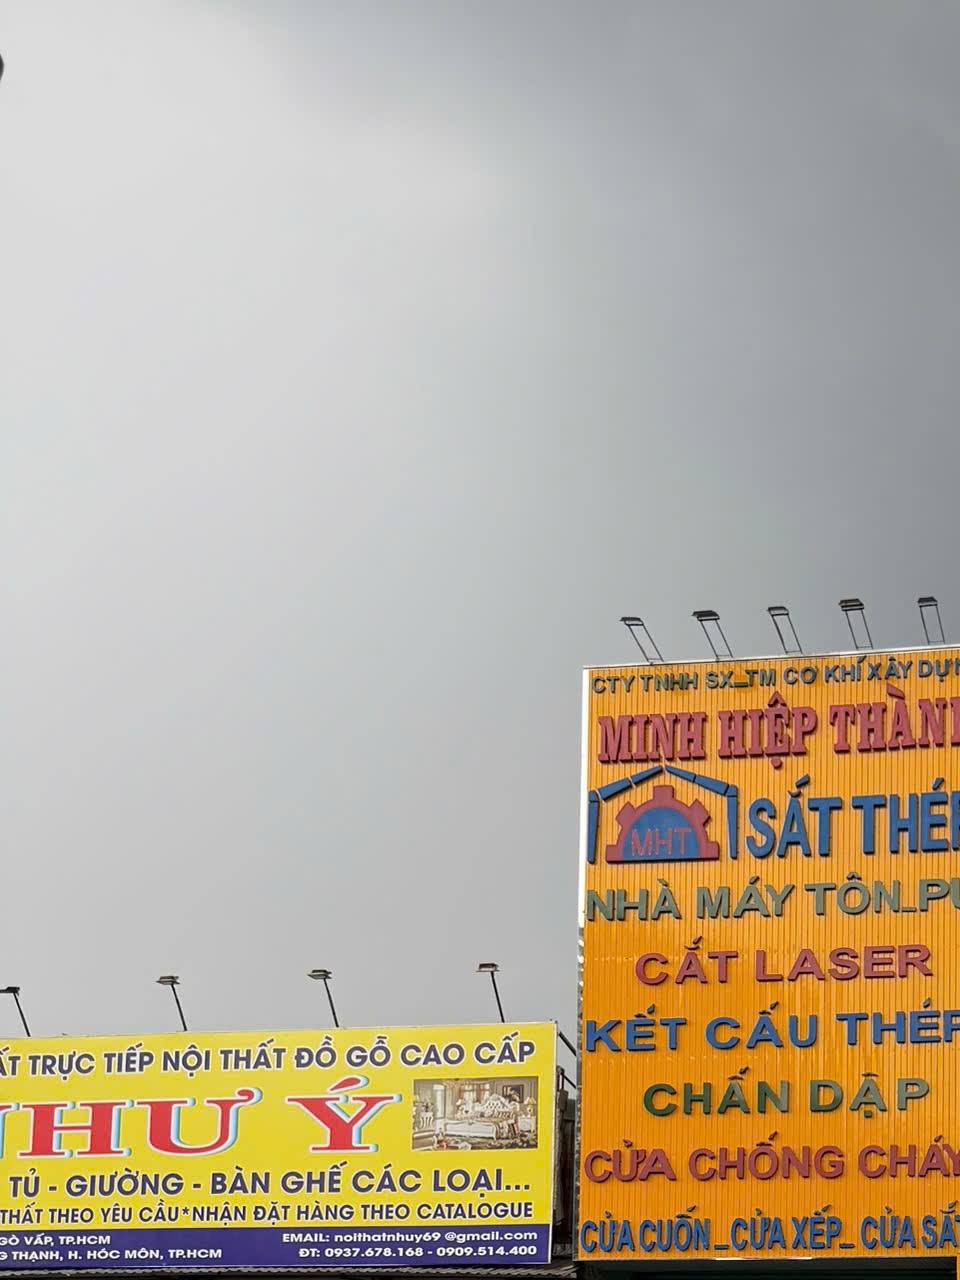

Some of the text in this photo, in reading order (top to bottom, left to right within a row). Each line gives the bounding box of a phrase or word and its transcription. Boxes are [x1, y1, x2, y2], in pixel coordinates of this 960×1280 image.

[591, 675, 634, 694] CTY
[640, 670, 698, 693] TNHH
[783, 665, 817, 685] CƠ
[824, 656, 867, 683] KHÍ
[868, 656, 913, 680] XÂY
[598, 712, 706, 763] MINH
[717, 691, 818, 770] HIỆP
[745, 774, 843, 859] SẮT
[631, 828, 692, 856] MHT
[586, 878, 681, 922] NHÀ
[695, 876, 795, 920] MÁY
[635, 936, 934, 985] CẮT LASER
[585, 1003, 687, 1052] KẾT
[705, 1001, 818, 1050] CẤU
[28, 1051, 95, 1080] TRỰC
[104, 1042, 154, 1074] TIẾP
[162, 1044, 211, 1077] NỘI
[220, 1038, 287, 1071] THẤT
[294, 1035, 338, 1068] ĐỒ
[346, 1035, 392, 1067] GỖ
[400, 1042, 466, 1067] CAO
[474, 1031, 536, 1064] CẤP
[643, 1066, 930, 1118] CHẤN DẬP
[0, 1074, 403, 1159] HƯ Ý
[583, 1139, 677, 1183] CỬA
[687, 1131, 845, 1181] CHỐNG
[9, 1168, 41, 1198] TỦ
[65, 1168, 184, 1197] GIƯỜNG
[210, 1166, 271, 1195] BÀN
[280, 1161, 348, 1194] GHẾ
[351, 1163, 422, 1192] CÁC
[0, 1203, 44, 1225] THẤT
[49, 1208, 95, 1224] THEO
[100, 1204, 133, 1223] YÊU
[253, 1201, 290, 1226] ĐẶT
[296, 1200, 355, 1221] HÀNG
[361, 1204, 410, 1220] THEO
[416, 1202, 533, 1220] CATALOGUE
[580, 1211, 635, 1253] CỬA
[12, 1251, 64, 1263] THẠNH,
[68, 1250, 83, 1260] H.
[87, 1246, 121, 1260] HÓC
[124, 1247, 165, 1261] MÔN,
[168, 1248, 223, 1260] TP.HCM
[24, 1233, 55, 1247] VẤP,
[59, 1235, 111, 1246] TP.HCM
[282, 1230, 538, 1245] EMAIL: noithatnhuy69 @gmail.com
[298, 1247, 321, 1258] ĐT:
[325, 1246, 424, 1258] 0937.678.168
[436, 1245, 537, 1256] 0909.514.400
